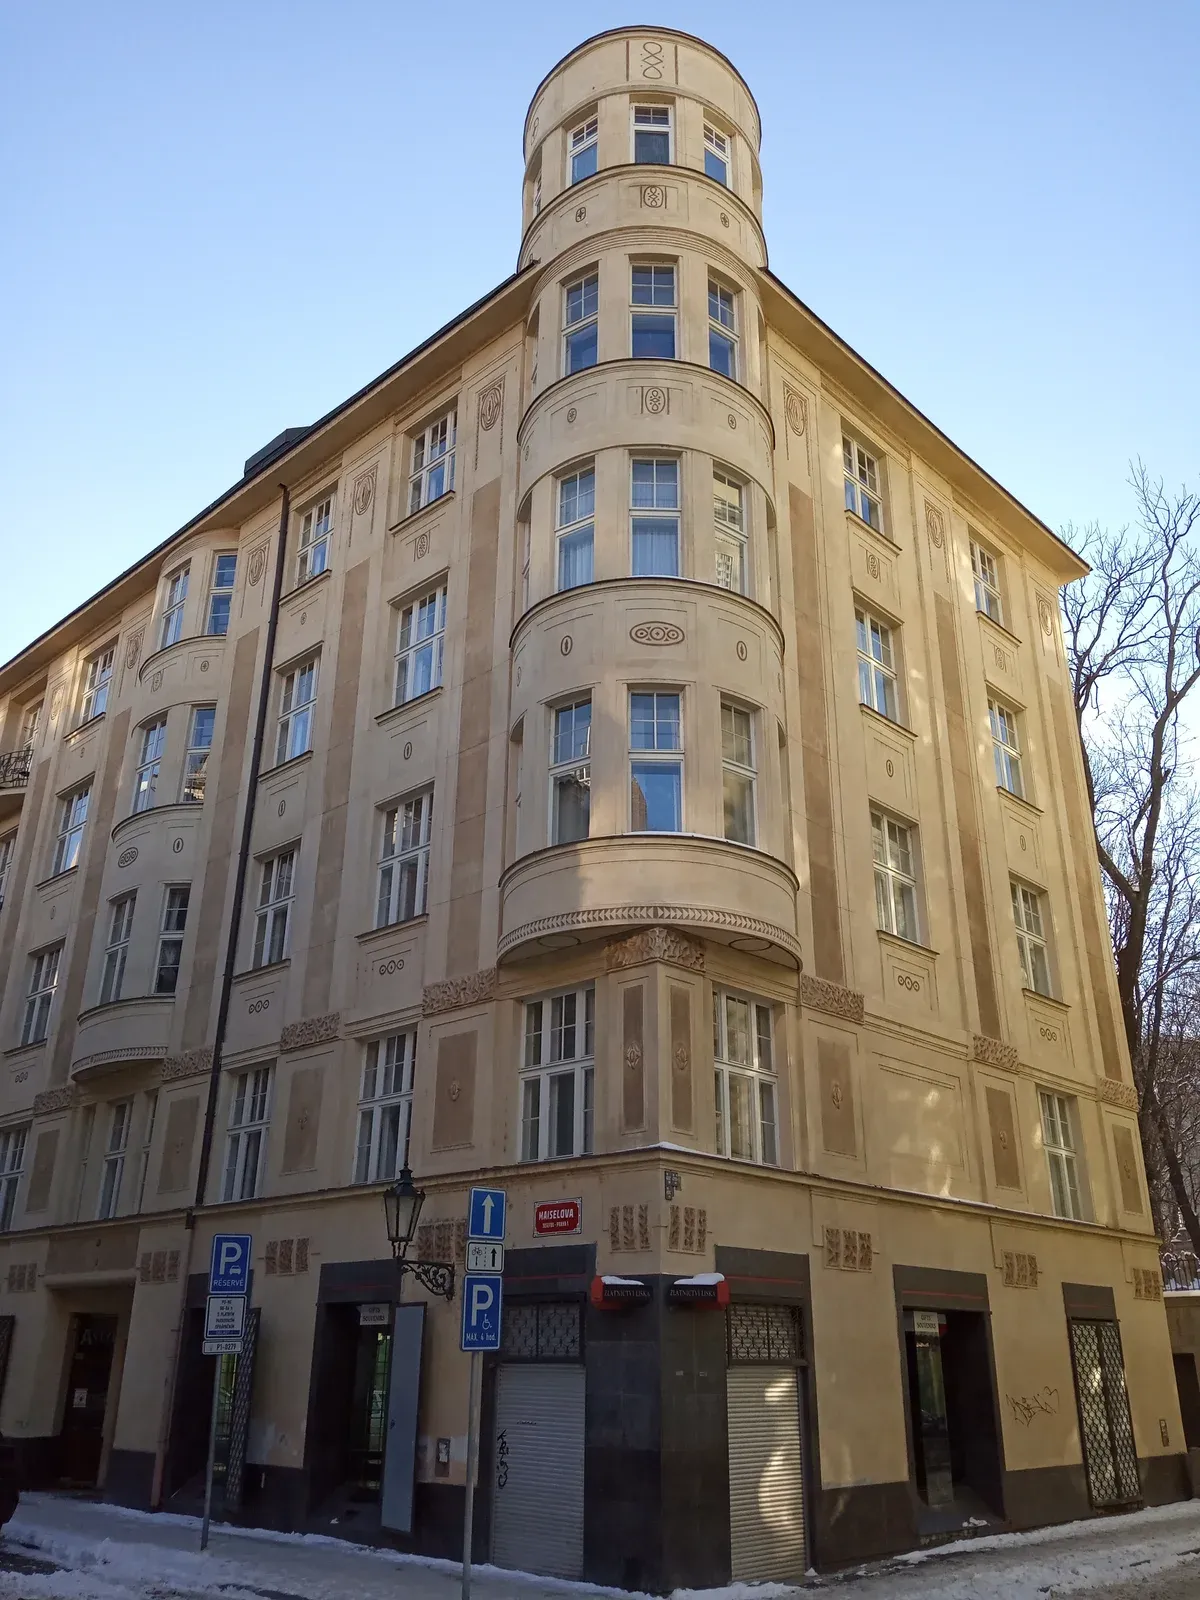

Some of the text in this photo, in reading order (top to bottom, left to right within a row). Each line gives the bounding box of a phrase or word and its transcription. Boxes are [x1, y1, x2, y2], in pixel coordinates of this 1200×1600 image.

[538, 1208, 574, 1220] MAISELOVA
[219, 1242, 242, 1275] P
[471, 1284, 494, 1326] P
